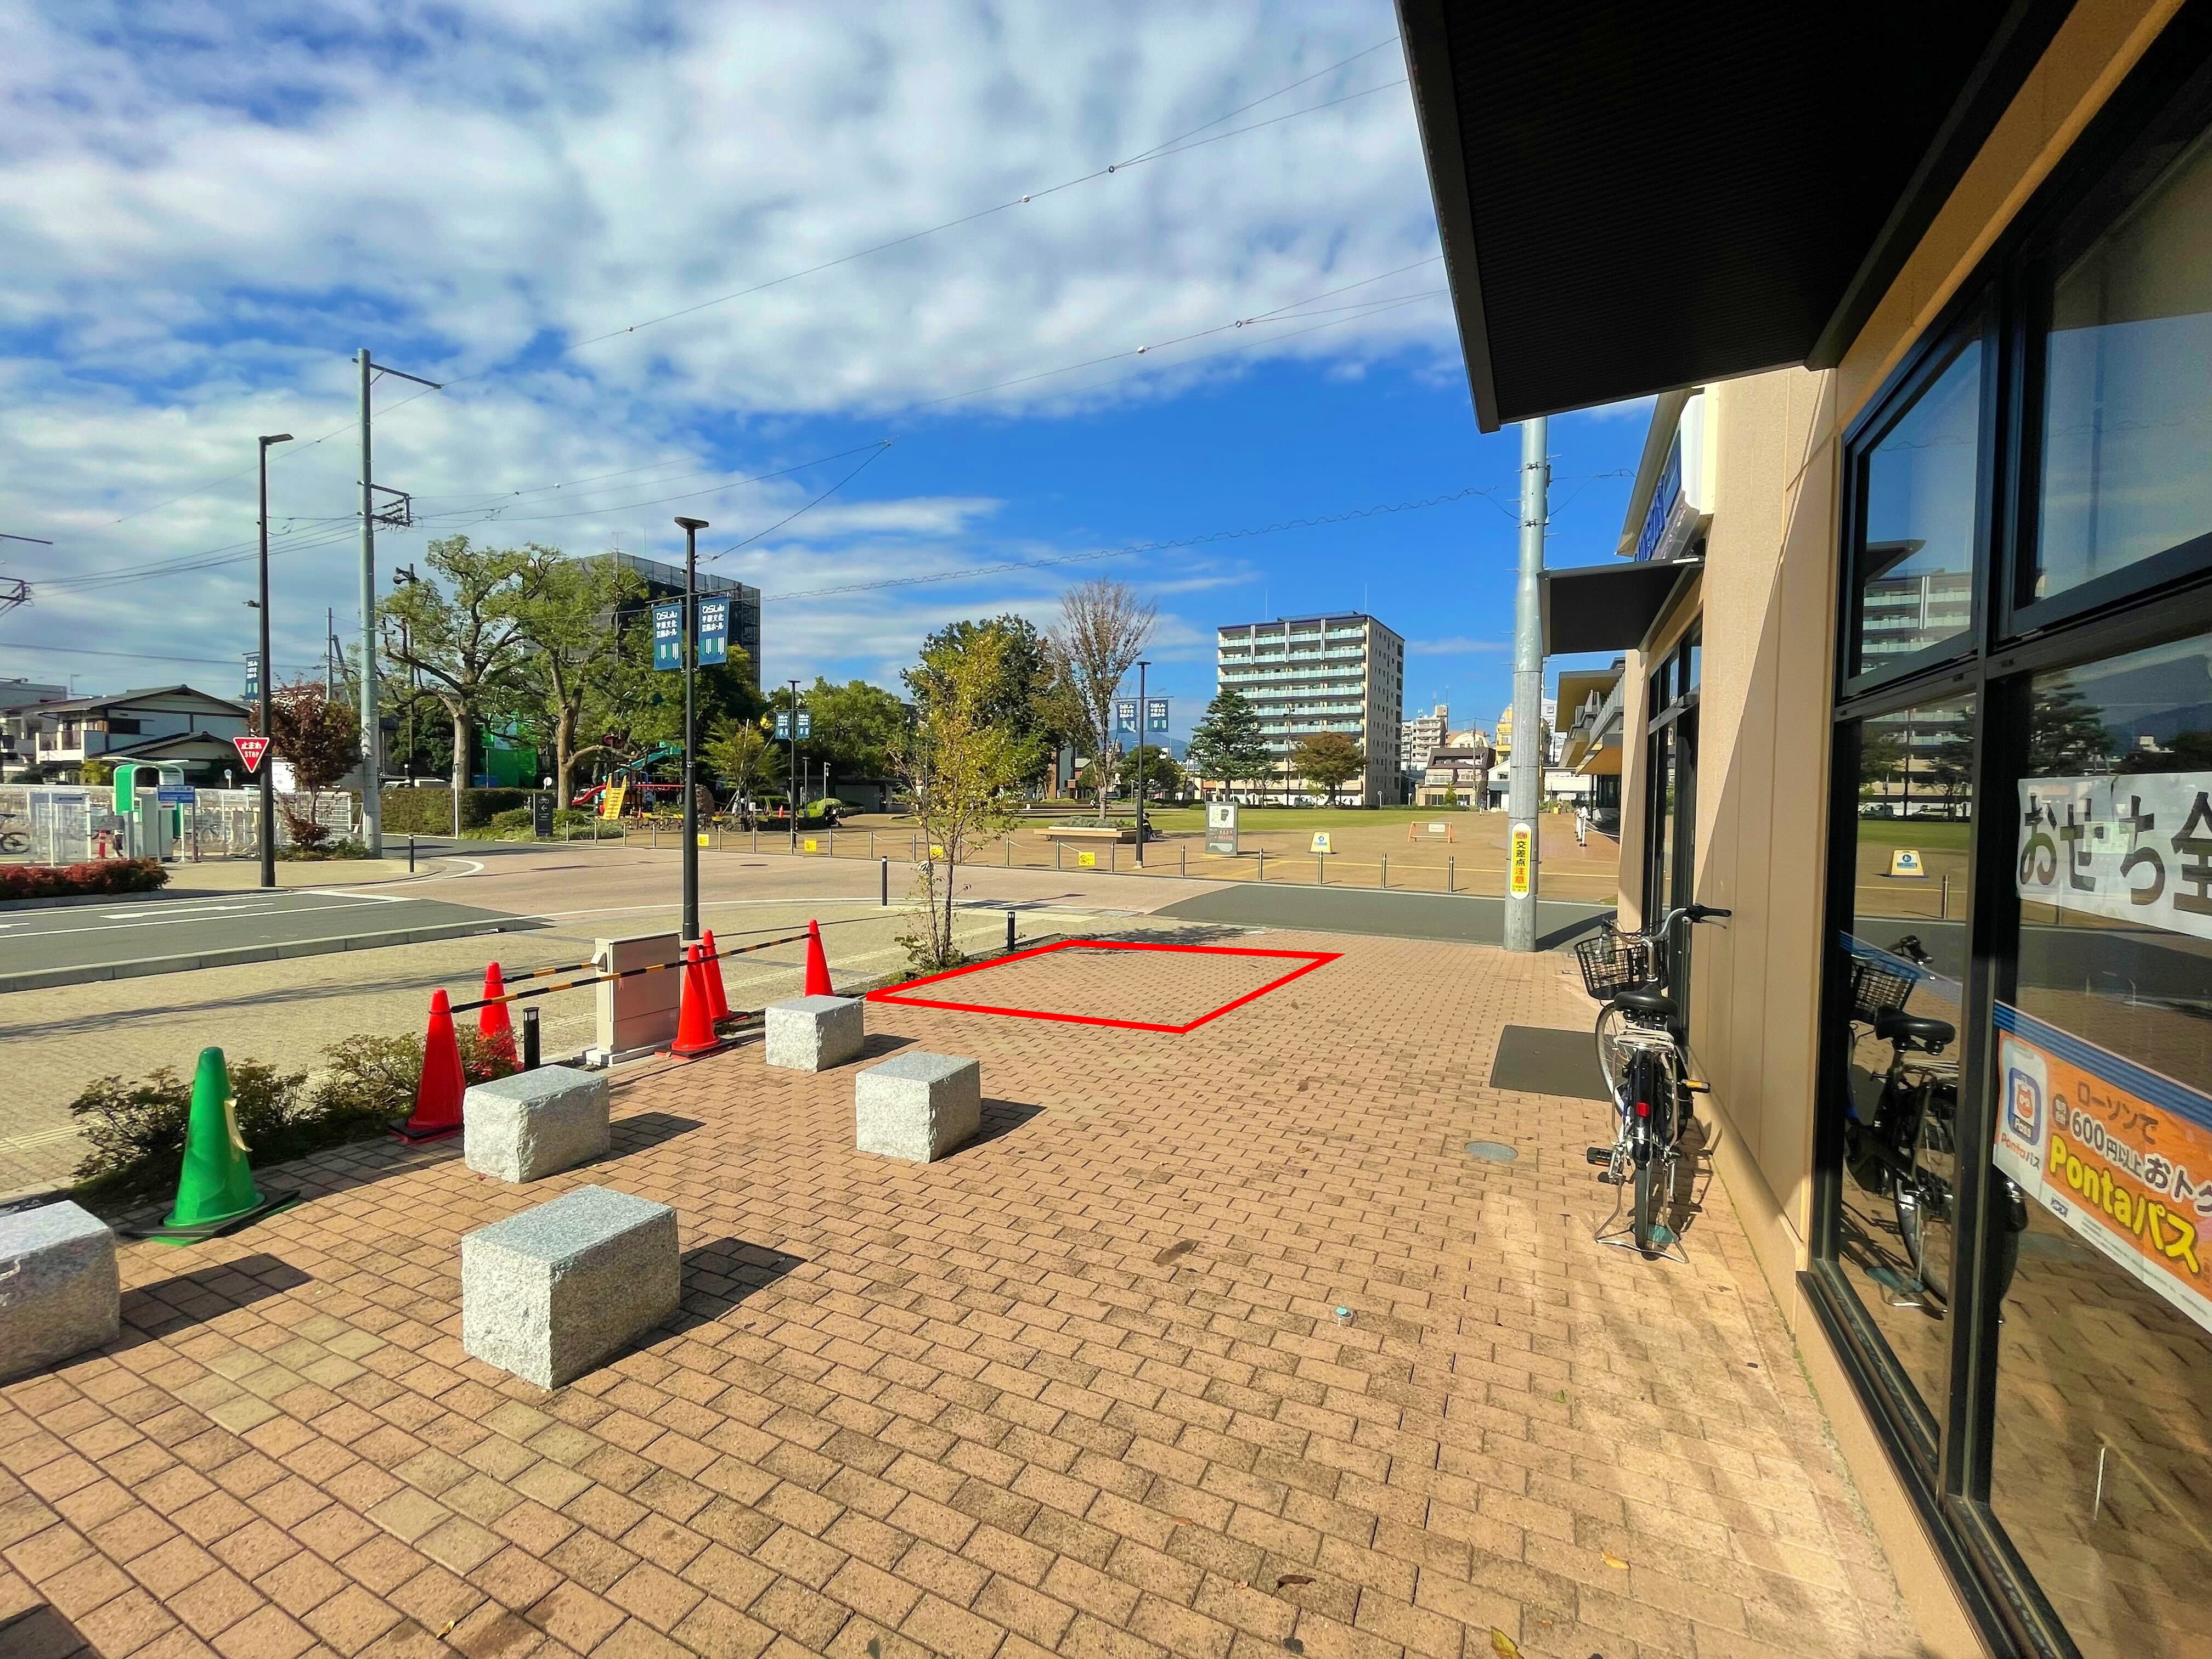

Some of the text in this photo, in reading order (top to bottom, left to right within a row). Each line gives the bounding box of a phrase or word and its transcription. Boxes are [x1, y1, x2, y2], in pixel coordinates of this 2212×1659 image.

[240, 741, 263, 750] 止まれ
[1515, 840, 1527, 884] 交差点注意
[2078, 1080, 2159, 1146] ローソンで
[2049, 1133, 2200, 1274] Pontaパス
